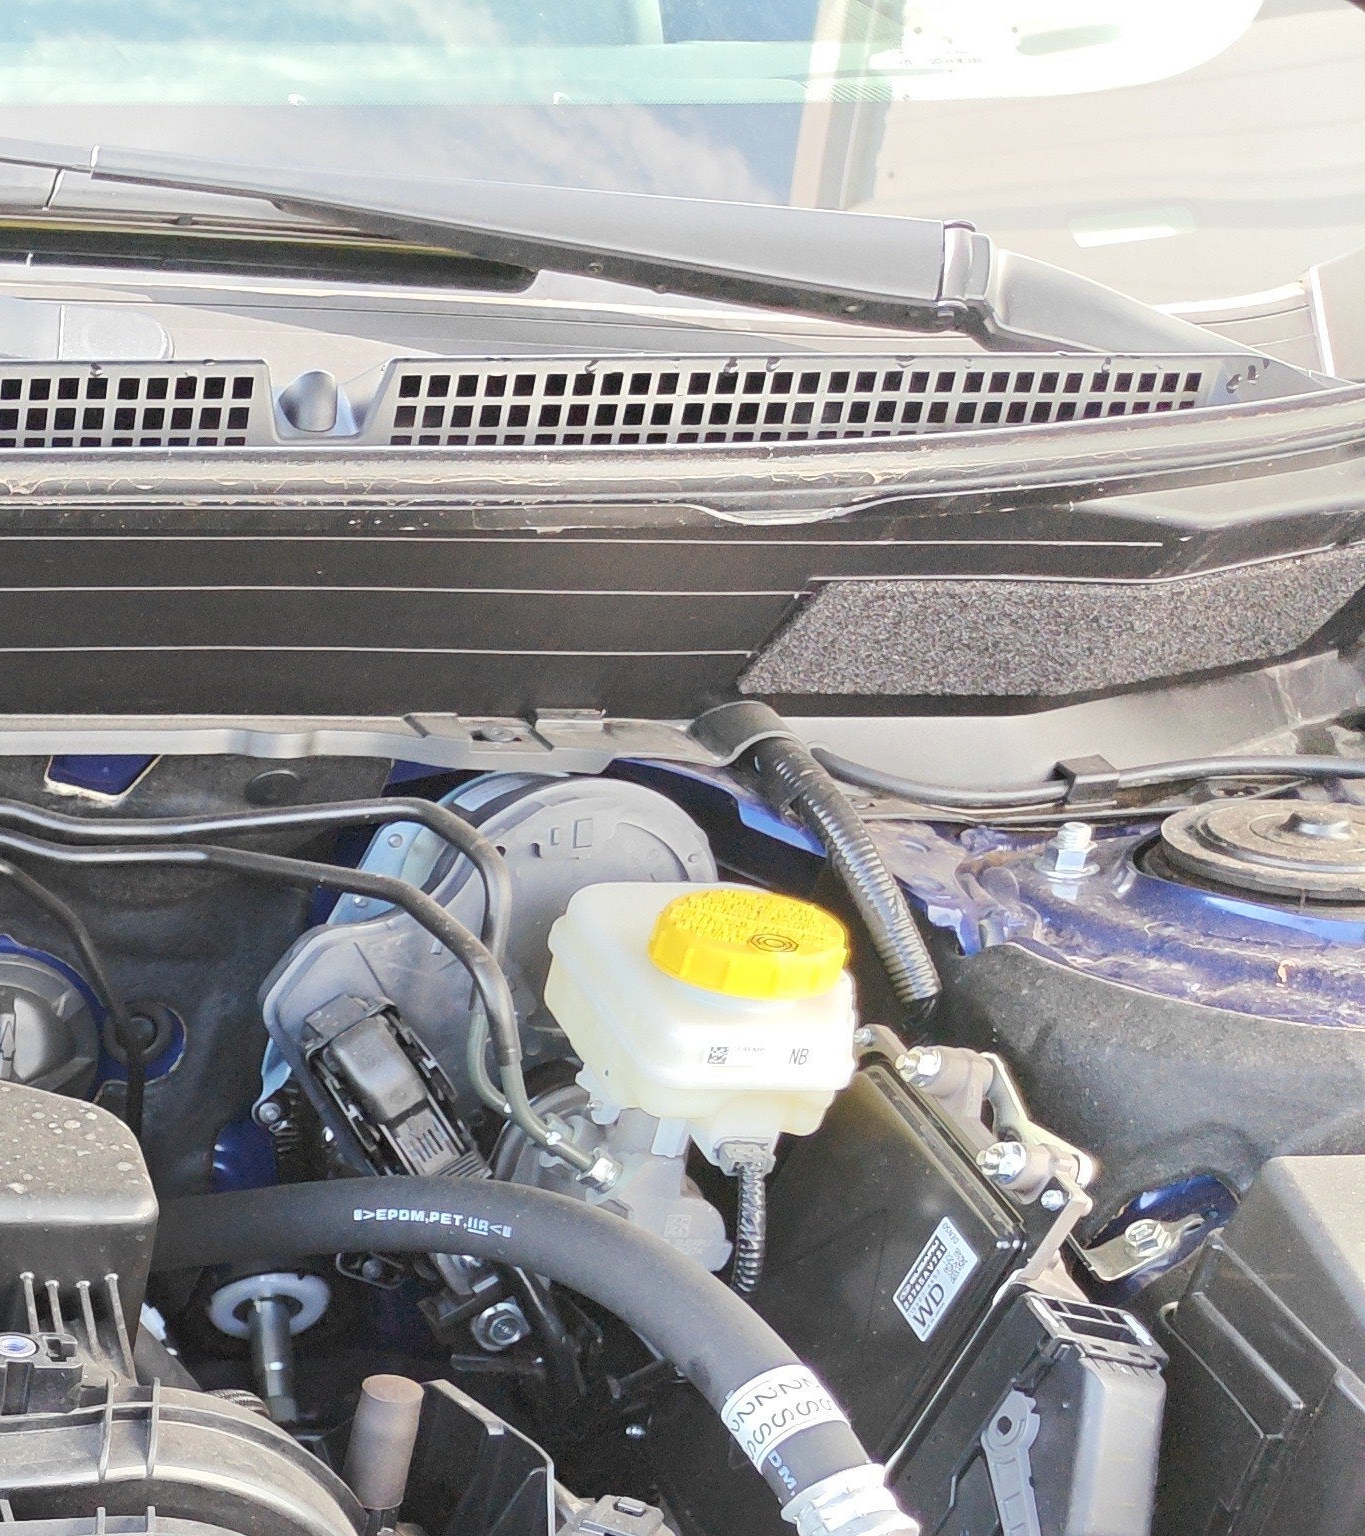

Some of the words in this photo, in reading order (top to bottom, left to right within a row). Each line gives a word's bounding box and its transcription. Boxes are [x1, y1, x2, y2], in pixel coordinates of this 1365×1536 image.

[788, 1048, 810, 1065] NB
[913, 1284, 945, 1327] WD
[754, 1387, 778, 1406] 2
[769, 1405, 795, 1430] S
[777, 1377, 802, 1394] 2
[794, 1395, 820, 1418] S
[735, 1400, 757, 1423] 2
[750, 1420, 773, 1446] S
